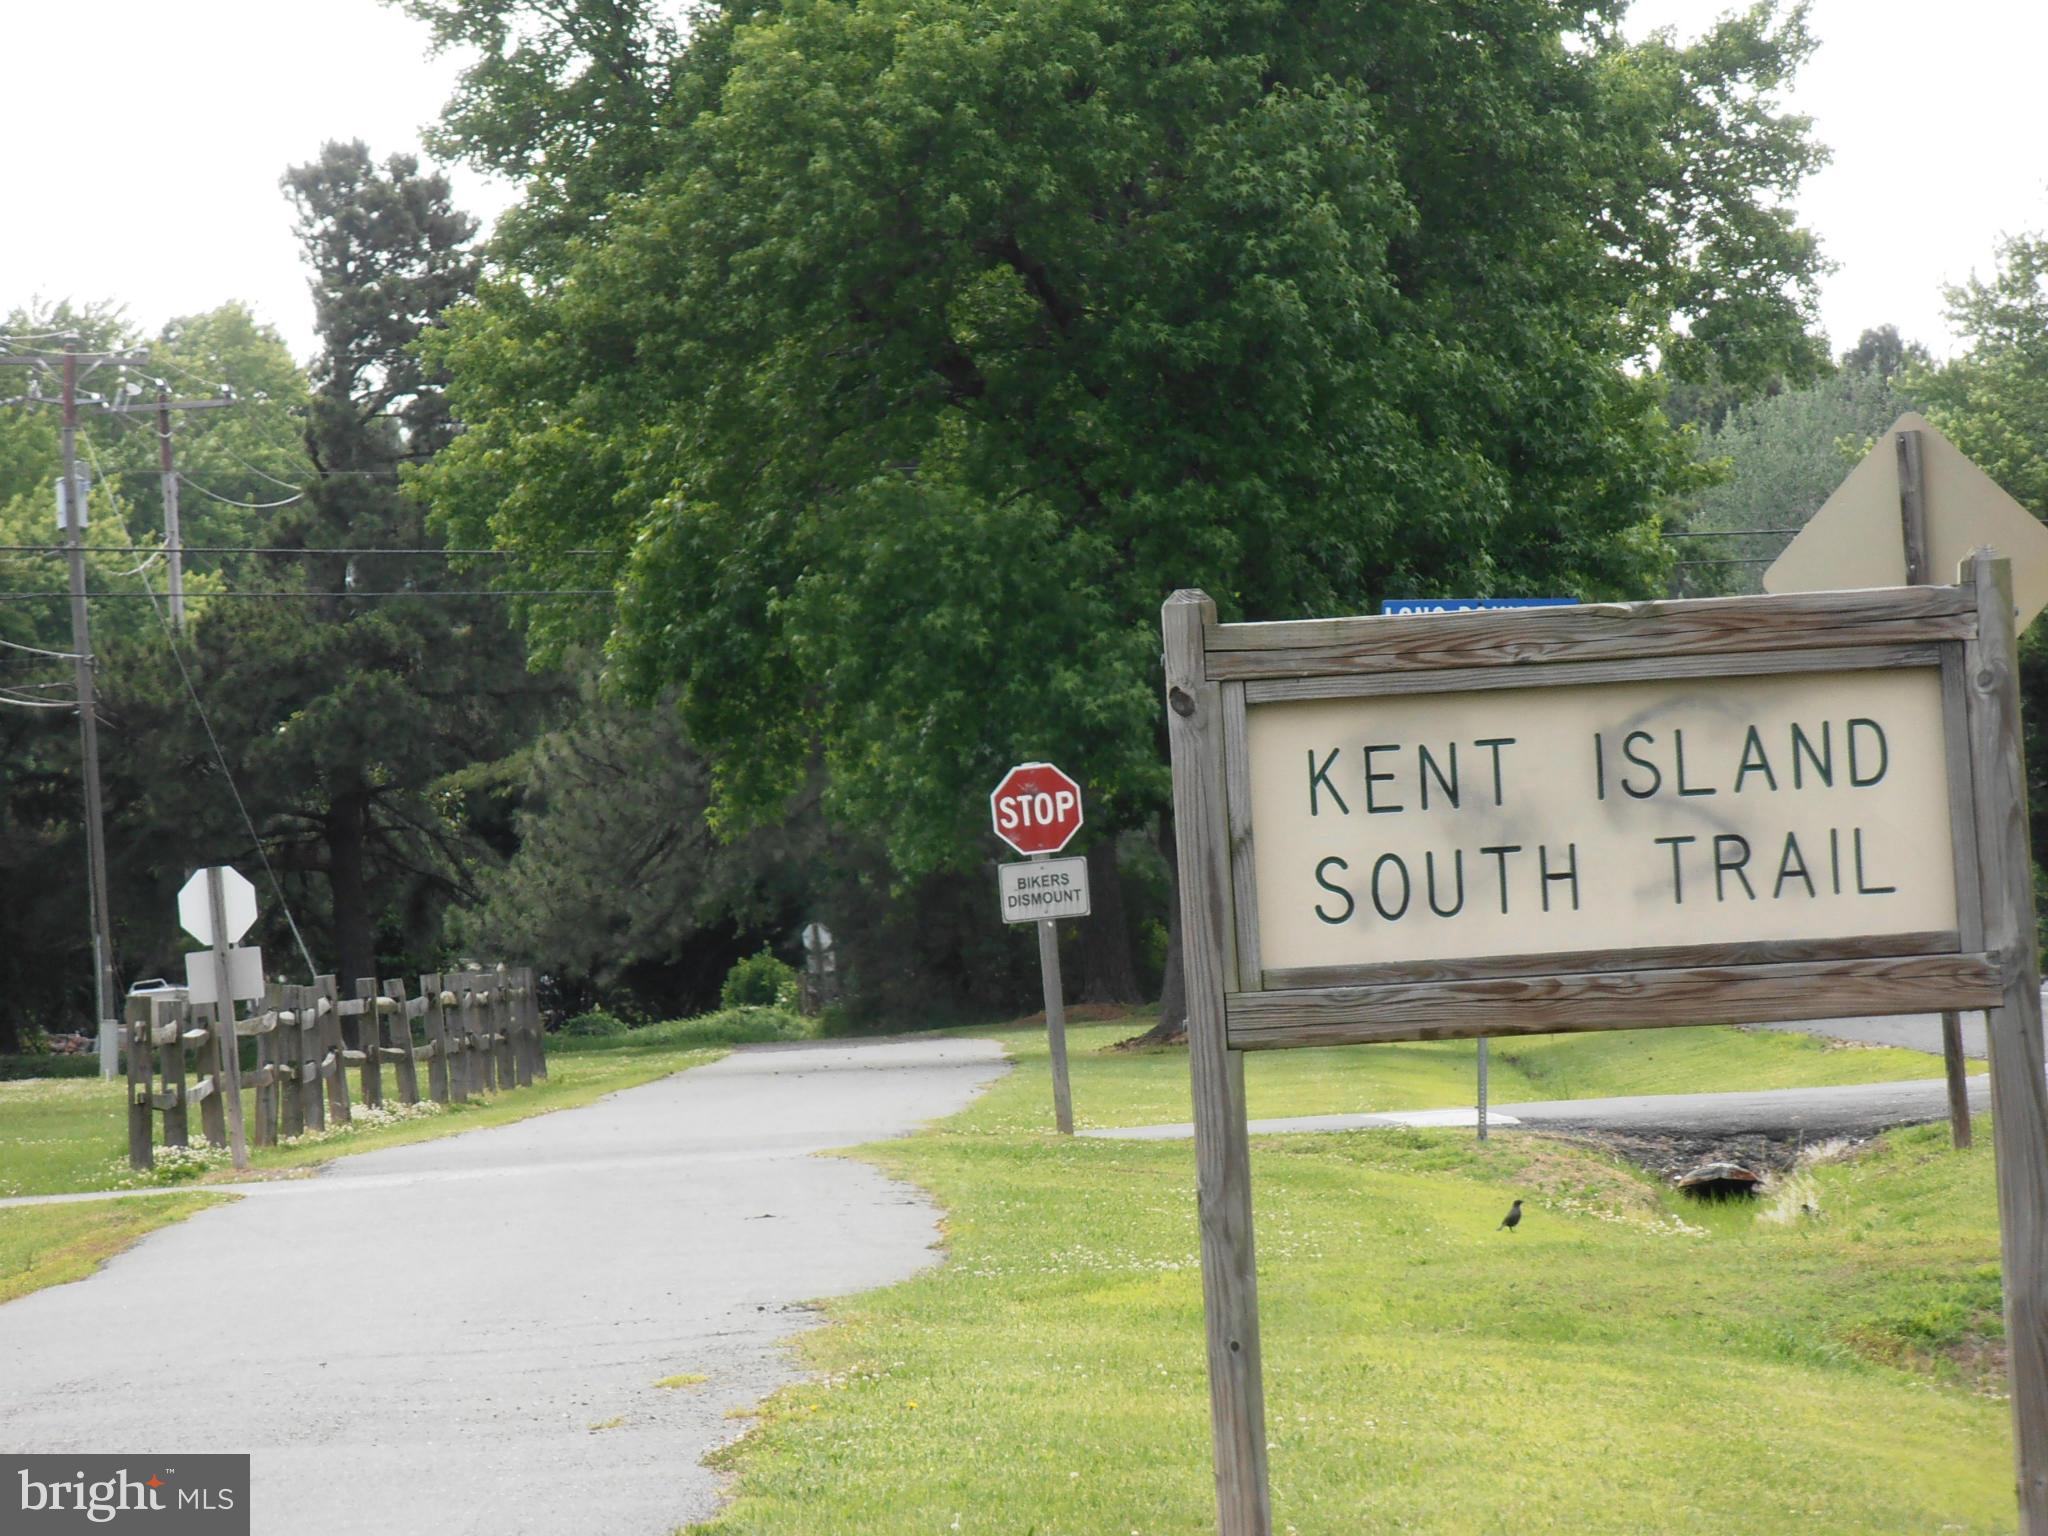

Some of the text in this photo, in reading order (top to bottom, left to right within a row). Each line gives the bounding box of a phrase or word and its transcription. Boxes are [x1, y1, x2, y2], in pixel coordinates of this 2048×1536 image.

[1307, 717, 1890, 817] KENT ISLAND
[999, 791, 1075, 829] STOP
[1017, 873, 1070, 890] BIKERS
[1313, 826, 1897, 925] SOUTH TRAIL
[1008, 889, 1082, 908] DISMOUNT
